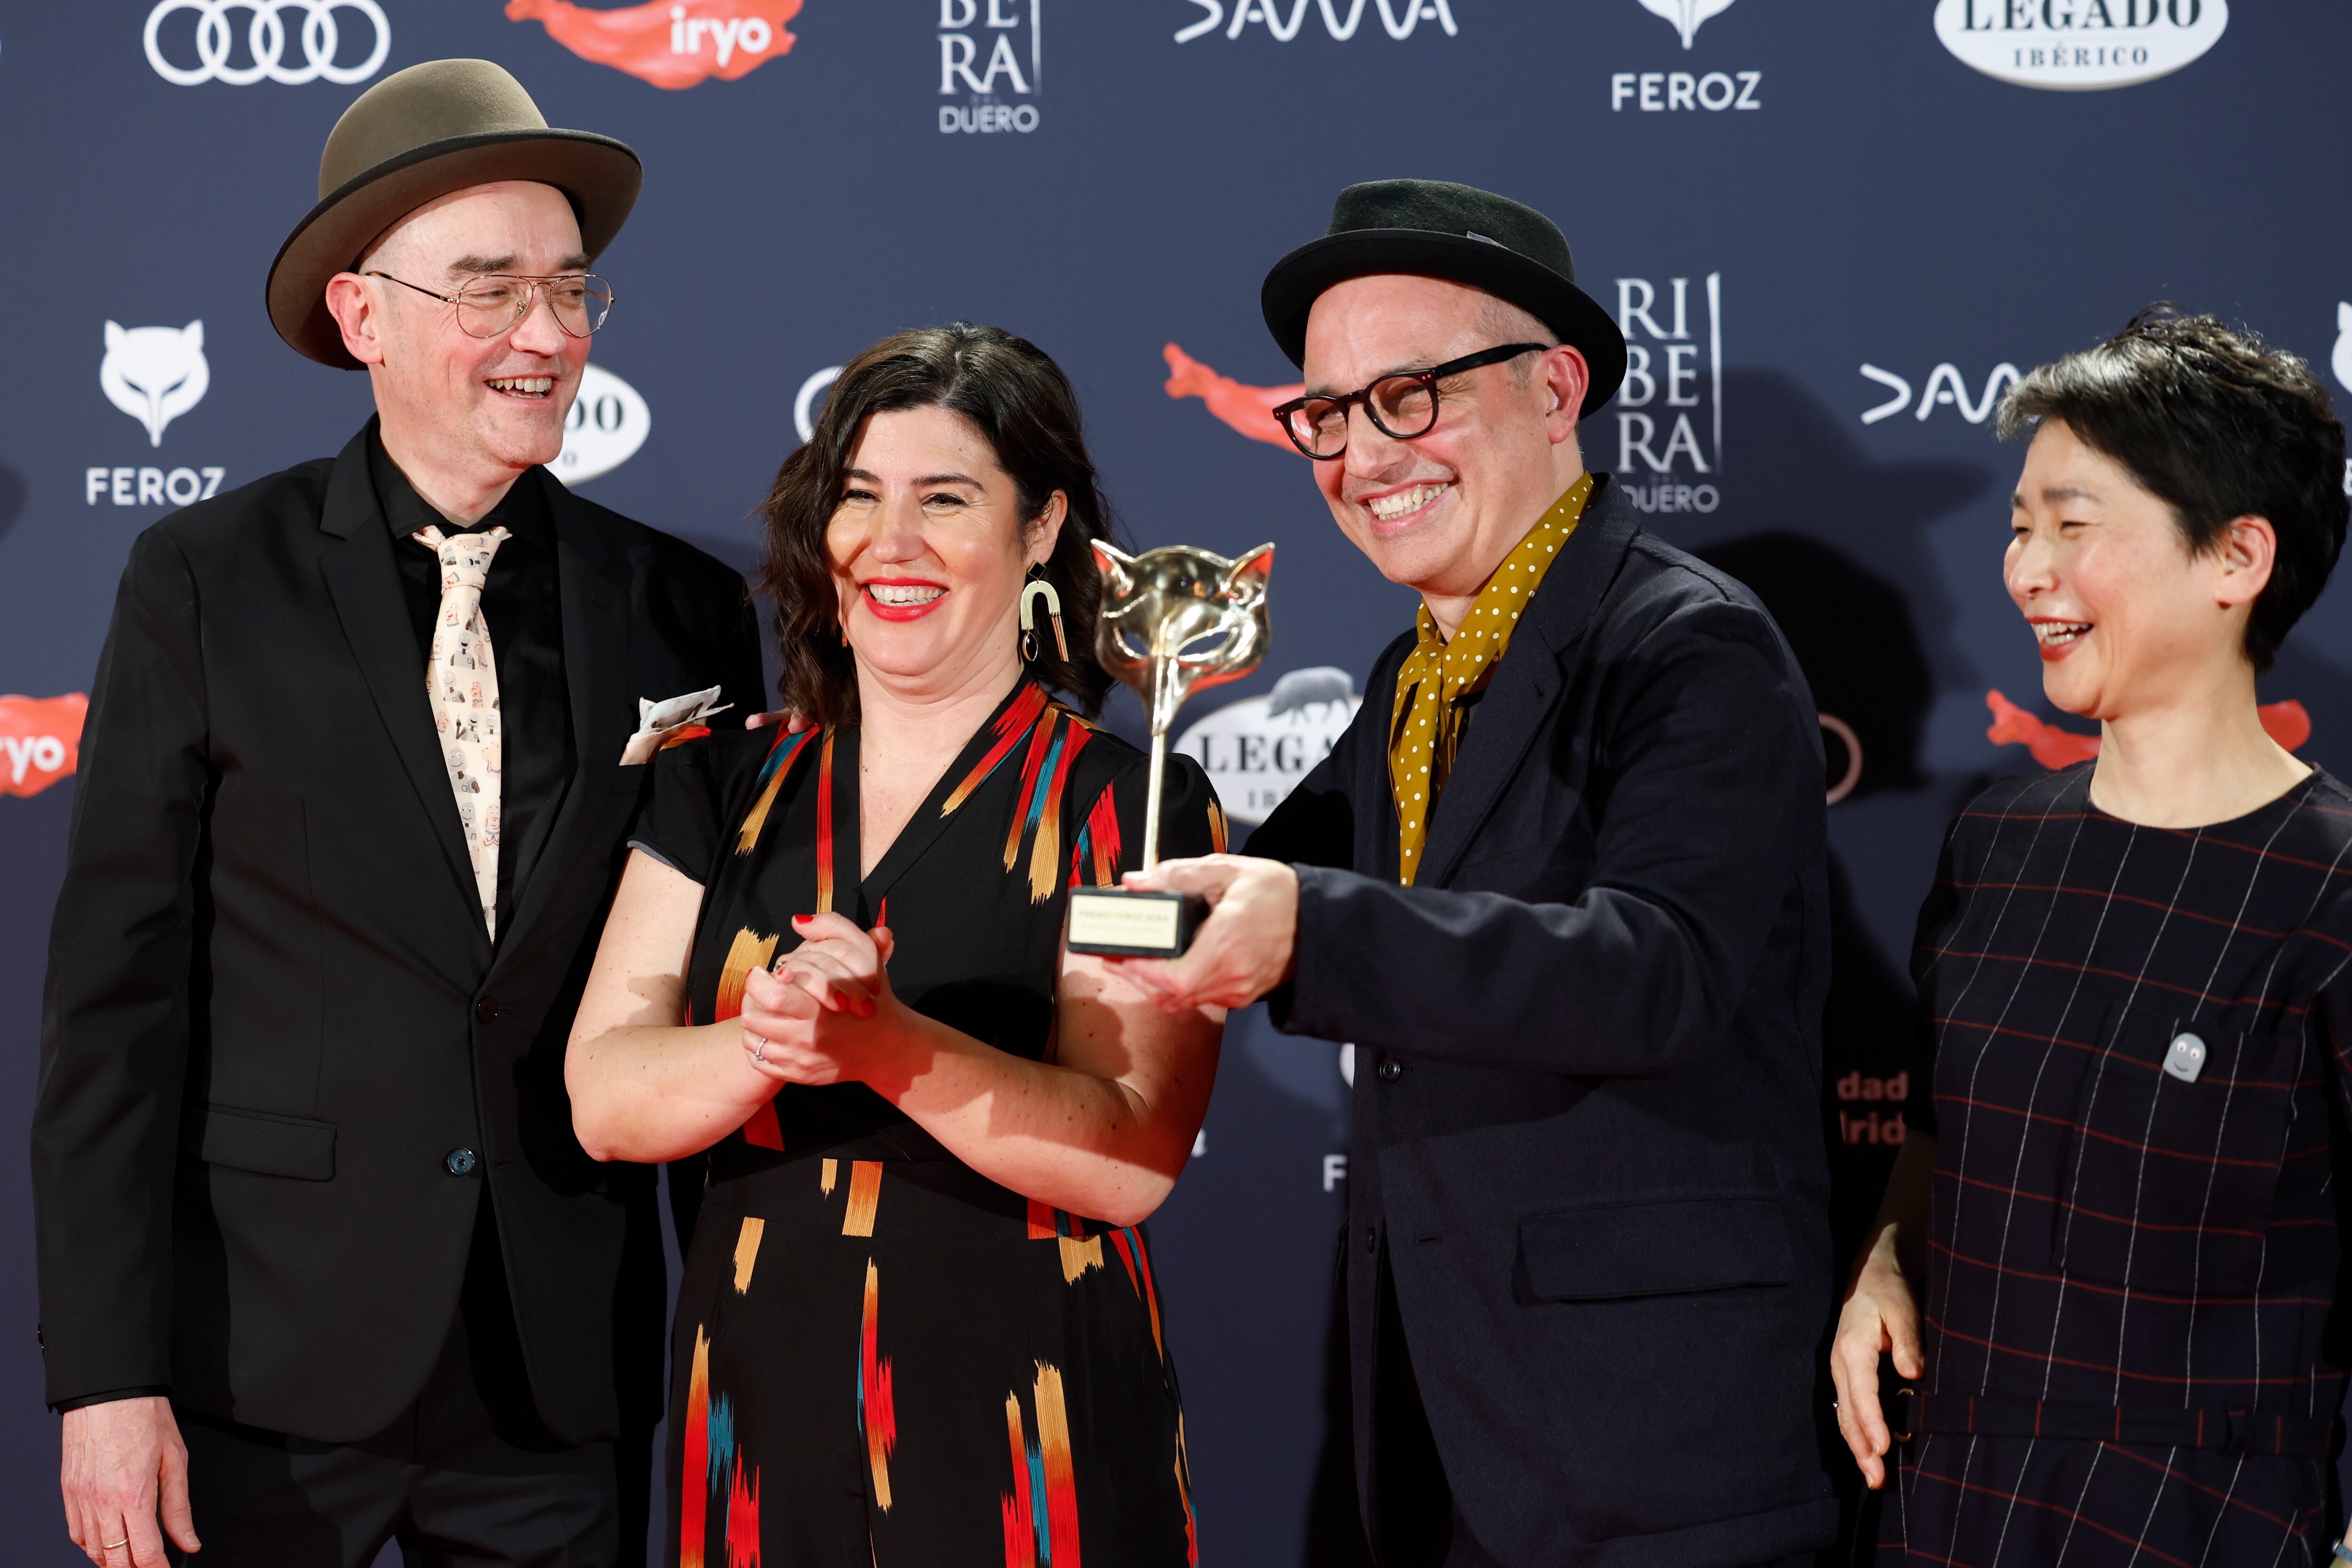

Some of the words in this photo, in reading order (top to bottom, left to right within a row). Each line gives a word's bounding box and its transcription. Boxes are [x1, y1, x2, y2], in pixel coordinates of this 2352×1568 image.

[1960, 0, 2201, 31] LEGADO
[670, 5, 772, 68] iryo
[2014, 42, 2149, 67] IBÉRICO
[1611, 72, 1762, 111] FEROZ
[939, 104, 1040, 134] DUERO
[86, 466, 226, 506] FEROZ
